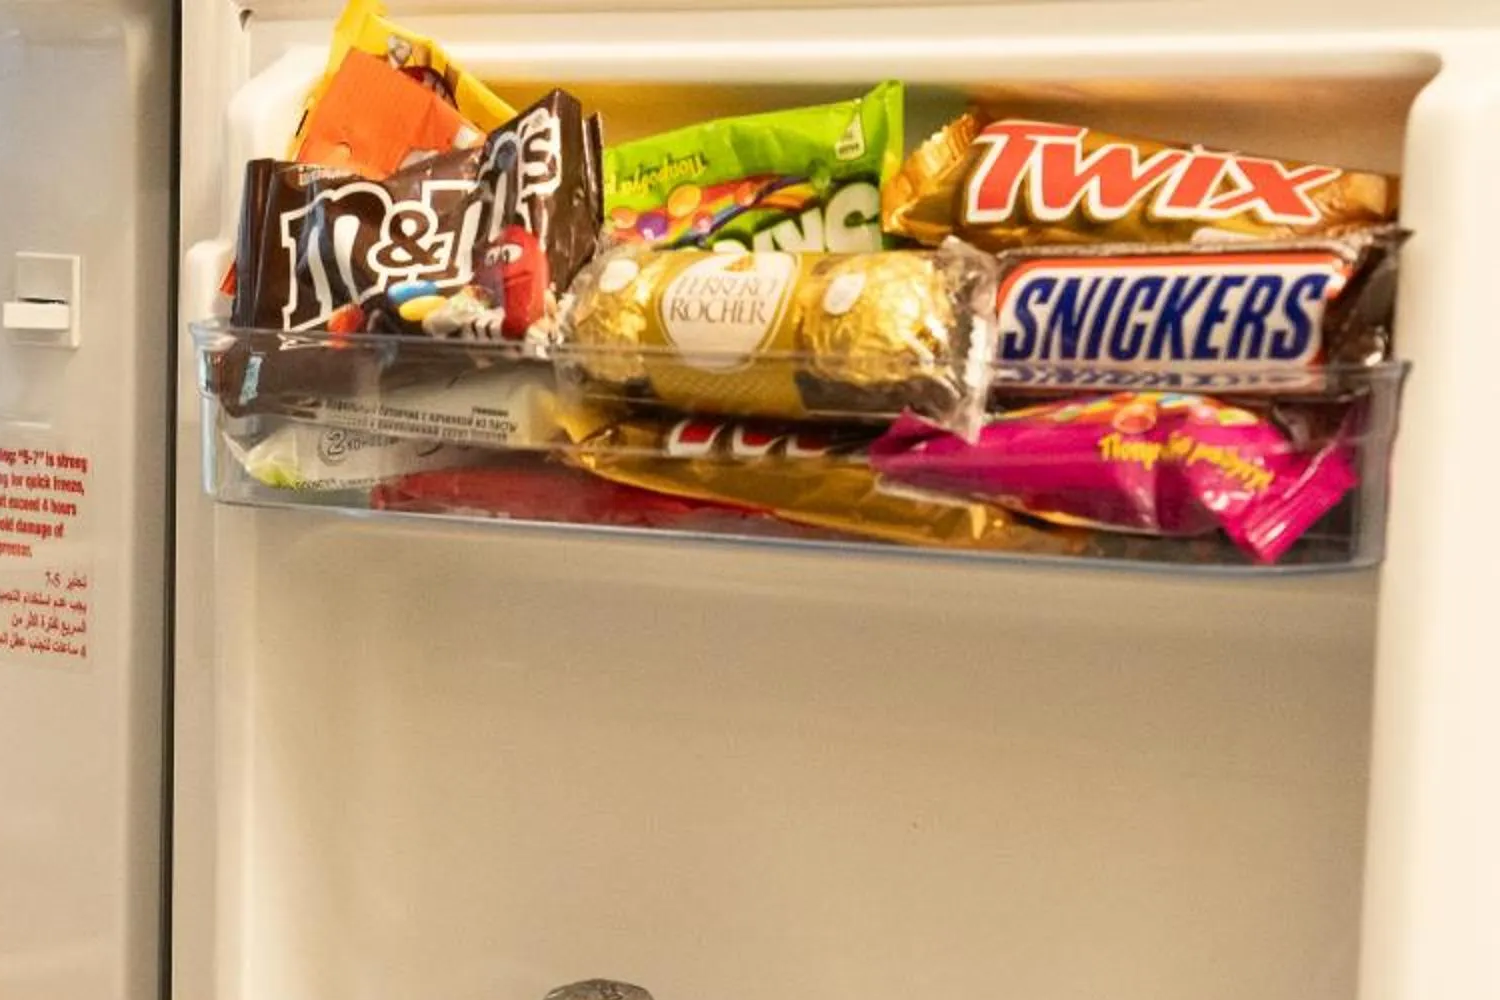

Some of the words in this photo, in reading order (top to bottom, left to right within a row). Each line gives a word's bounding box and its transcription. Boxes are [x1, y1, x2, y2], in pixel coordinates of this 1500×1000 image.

[669, 299, 768, 326] ROCHER
[1002, 273, 1330, 362] SNICKERS
[46, 451, 55, 467] is
[57, 454, 87, 473] strong
[11, 472, 24, 486] for
[26, 473, 50, 490] quick
[8, 497, 41, 511] exceed
[51, 499, 77, 516] hours
[16, 518, 53, 539] damage
[54, 522, 65, 537] of
